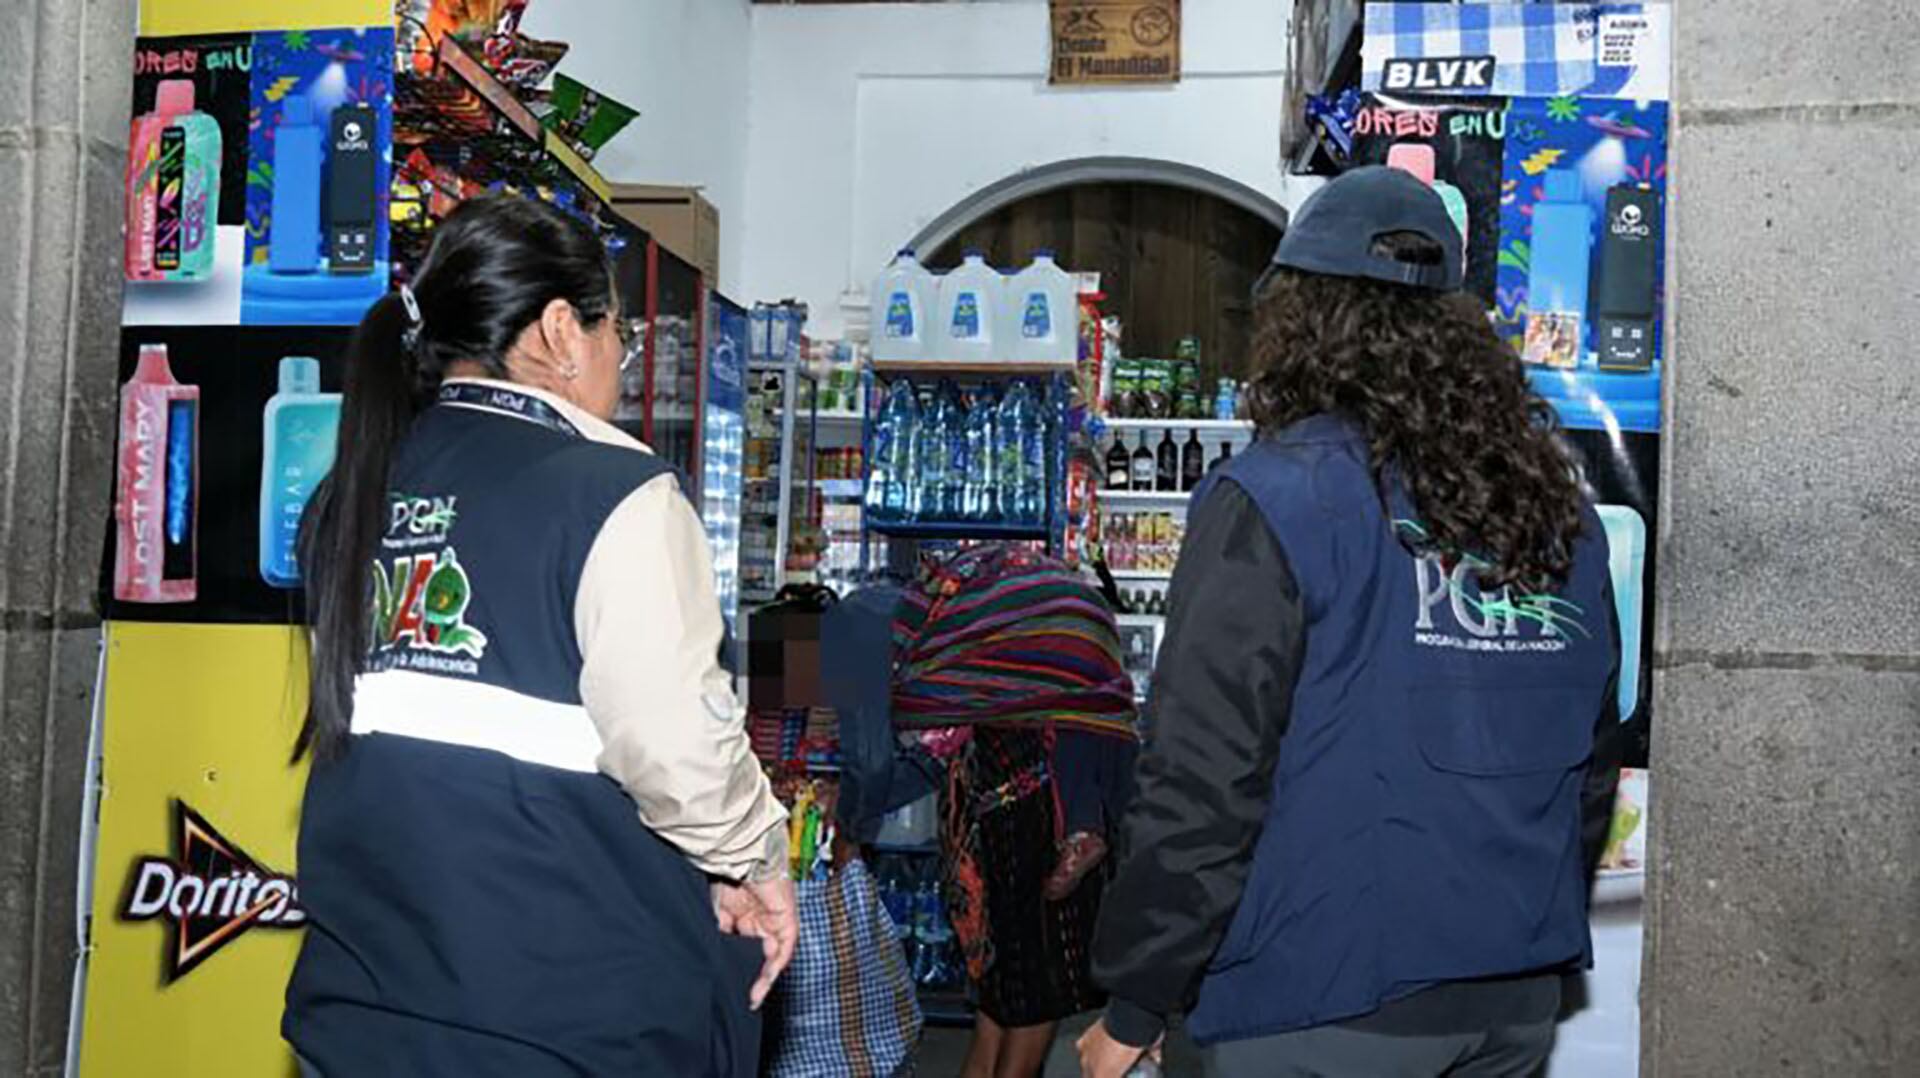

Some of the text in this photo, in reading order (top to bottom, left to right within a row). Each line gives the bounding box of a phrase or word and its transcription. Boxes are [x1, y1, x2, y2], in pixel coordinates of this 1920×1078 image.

[1385, 59, 1489, 88] BLVK
[132, 399, 154, 585] LOST MARY
